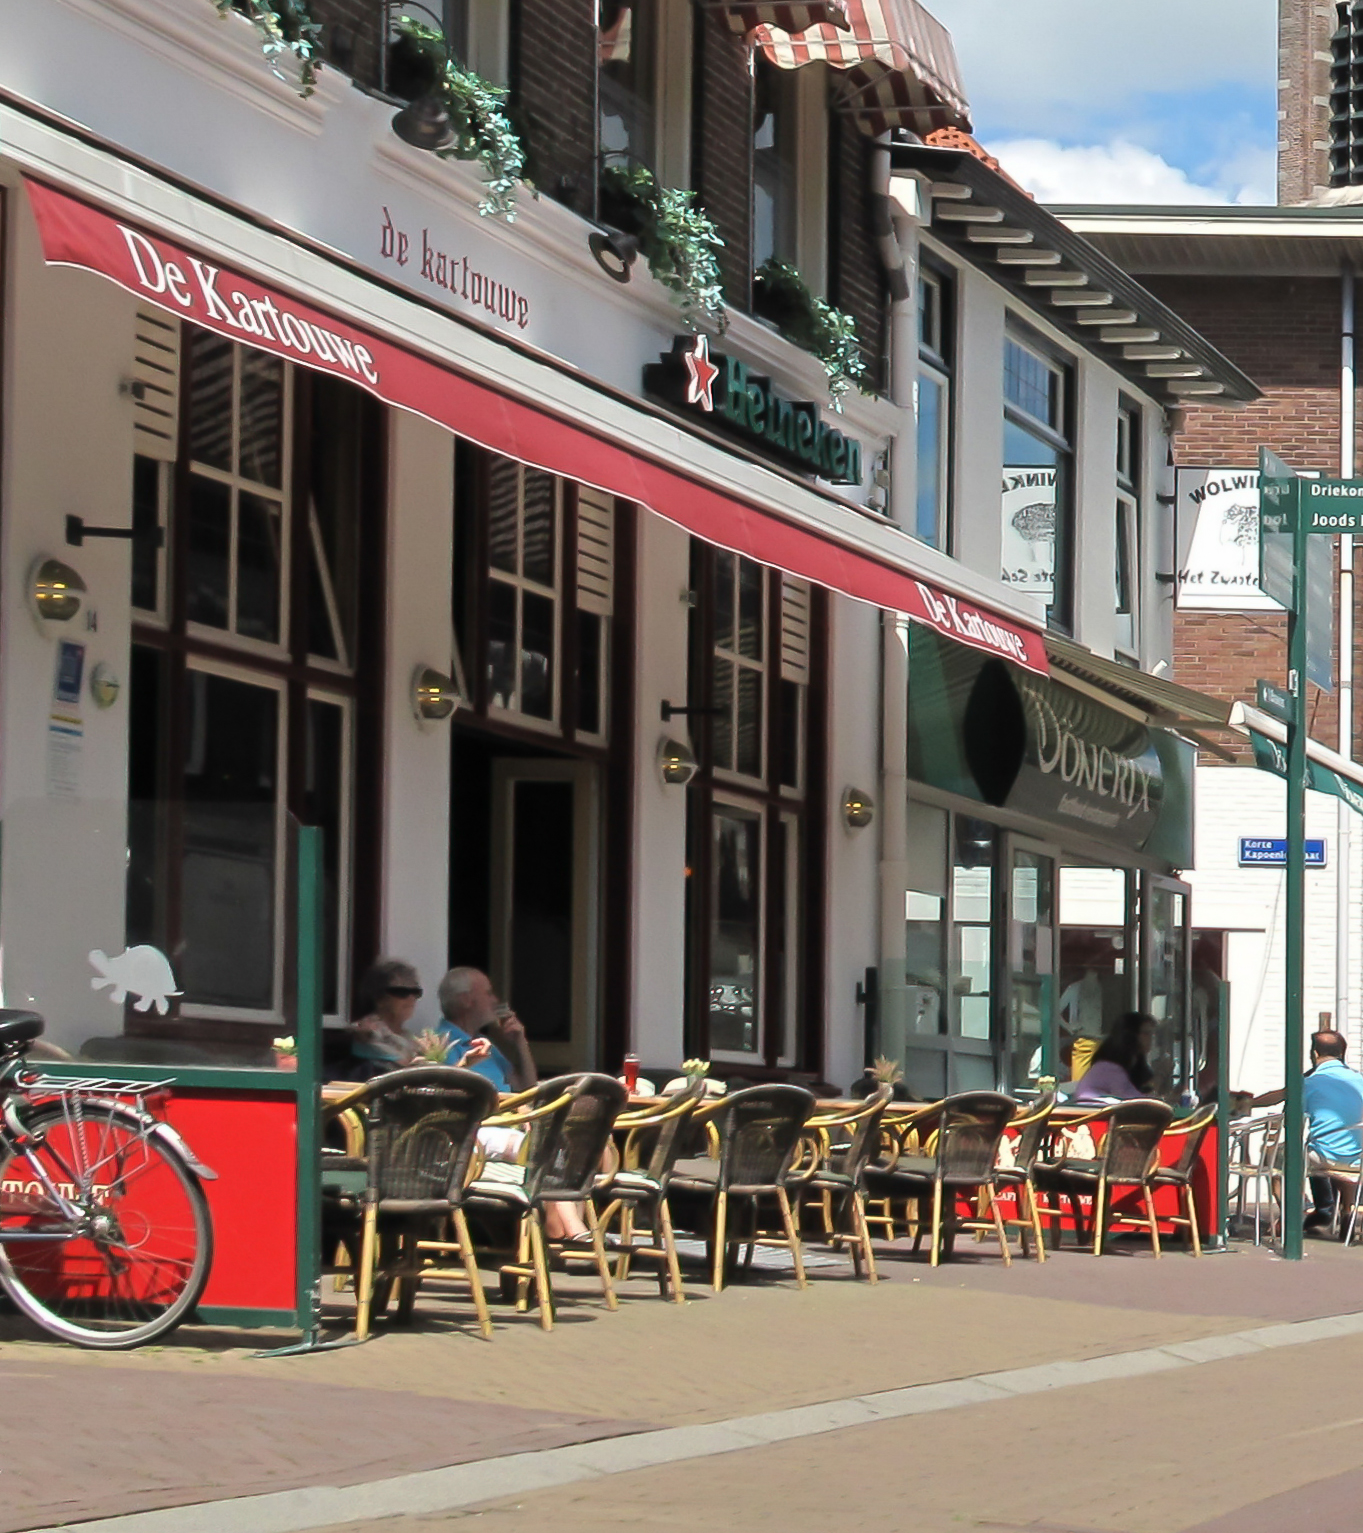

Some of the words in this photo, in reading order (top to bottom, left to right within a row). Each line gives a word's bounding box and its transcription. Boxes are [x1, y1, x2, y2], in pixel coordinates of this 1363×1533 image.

[380, 206, 408, 266] de
[116, 223, 192, 307] De
[186, 255, 379, 385] Kartouwe
[1312, 513, 1356, 527] Joods
[914, 580, 951, 628] De
